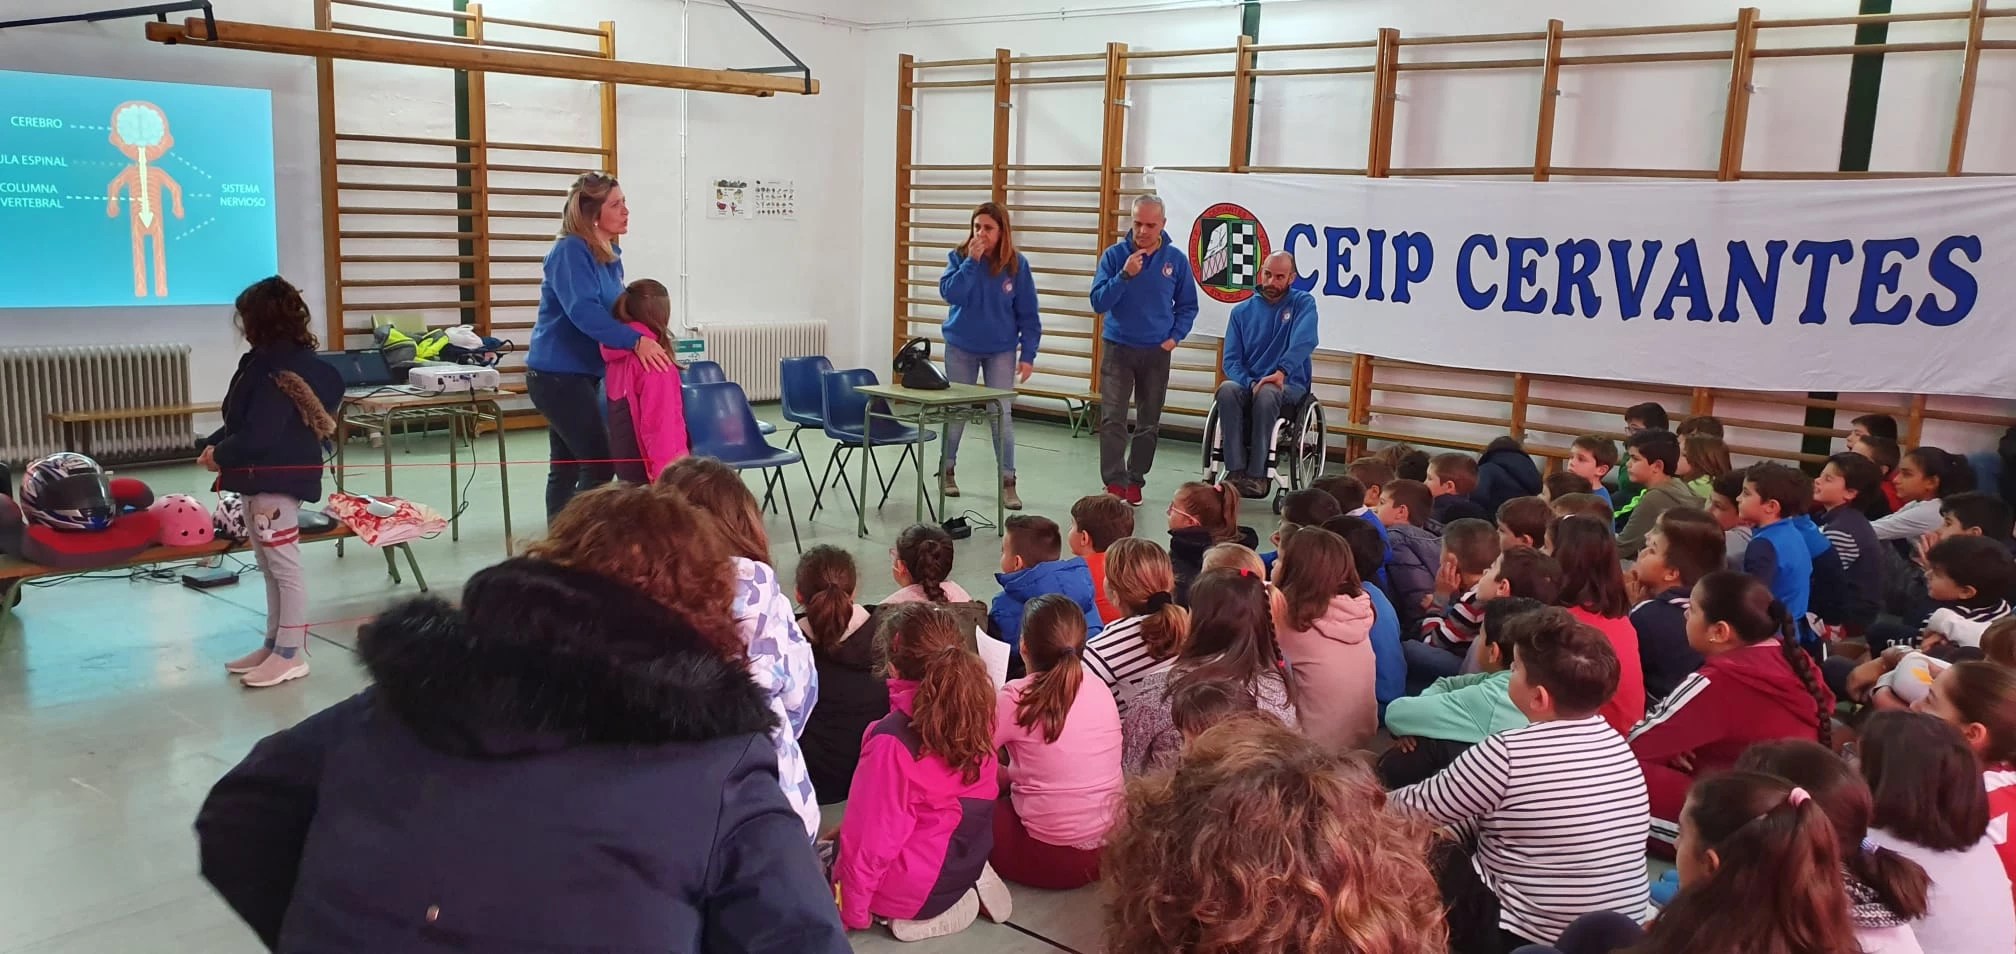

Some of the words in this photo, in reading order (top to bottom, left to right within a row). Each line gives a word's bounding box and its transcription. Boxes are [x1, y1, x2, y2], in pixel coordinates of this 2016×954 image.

[10, 116, 63, 129] CEREBRO
[21, 154, 68, 168] ESPINAL
[0, 182, 59, 194] COLUMNA
[221, 183, 261, 194] SISTEMA
[0, 197, 65, 209] VERTEBRAL
[219, 196, 267, 207] NERVIOSO
[1284, 222, 1435, 304] CEIP
[1456, 233, 1983, 327] CERVANTES
